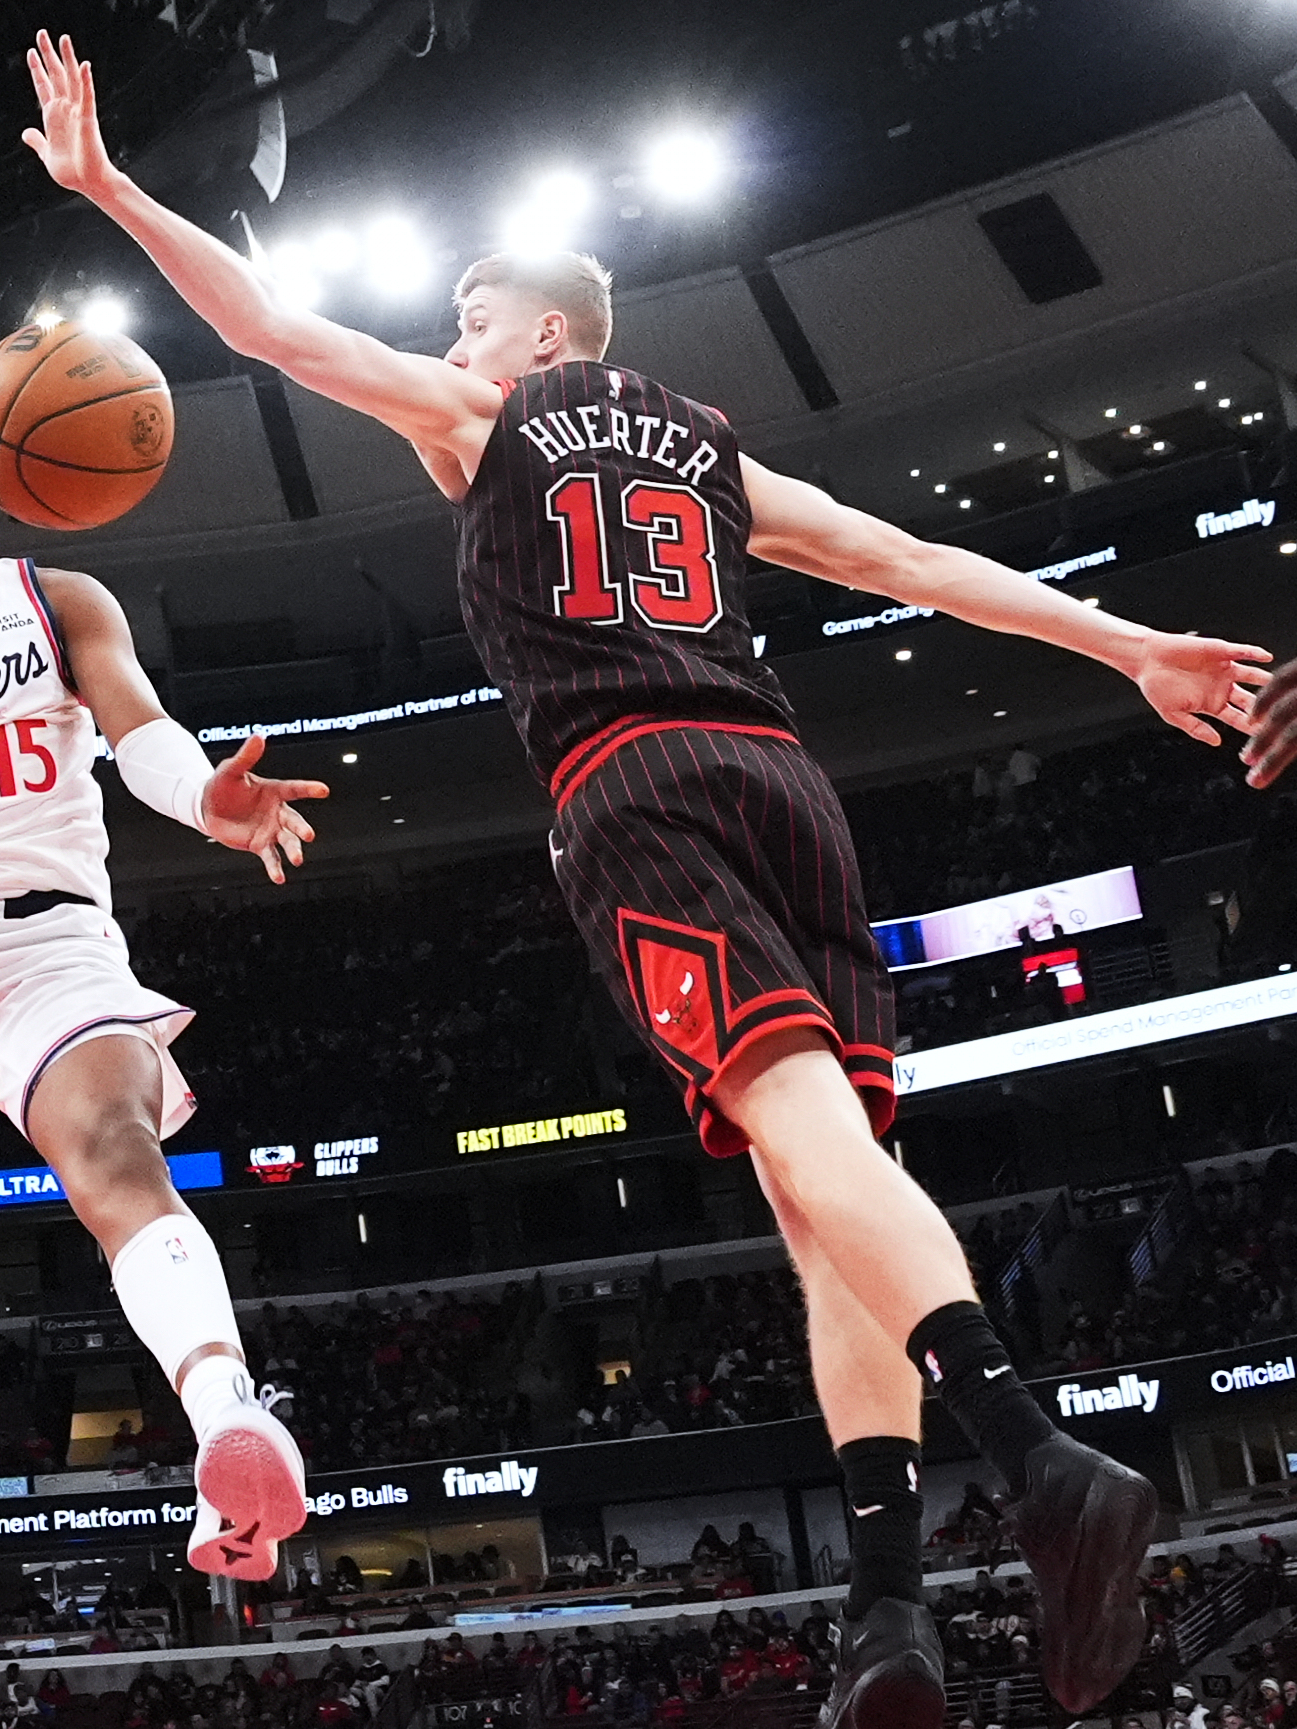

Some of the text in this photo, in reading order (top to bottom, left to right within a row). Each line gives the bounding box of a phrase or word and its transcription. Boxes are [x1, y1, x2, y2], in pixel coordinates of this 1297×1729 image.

[518, 405, 719, 486] HUERTER
[1195, 498, 1276, 538] finally
[545, 472, 724, 633] 13
[198, 724, 251, 743] Official
[303, 704, 403, 732] Management
[405, 695, 459, 716] Partner
[460, 689, 477, 705] of
[1012, 1032, 1071, 1057] Official
[1076, 1020, 1134, 1045] Spend
[1138, 991, 1265, 1030] Management
[314, 1137, 379, 1160] CLIPPERS
[457, 1109, 627, 1154] FAST BREAK POINTS
[316, 1157, 359, 1177] BULLS
[1057, 1356, 1296, 1417] finally Official
[351, 1484, 409, 1508] Bulls
[442, 1460, 538, 1497] finally
[53, 1507, 156, 1531] Platform
[160, 1502, 196, 1523] for
